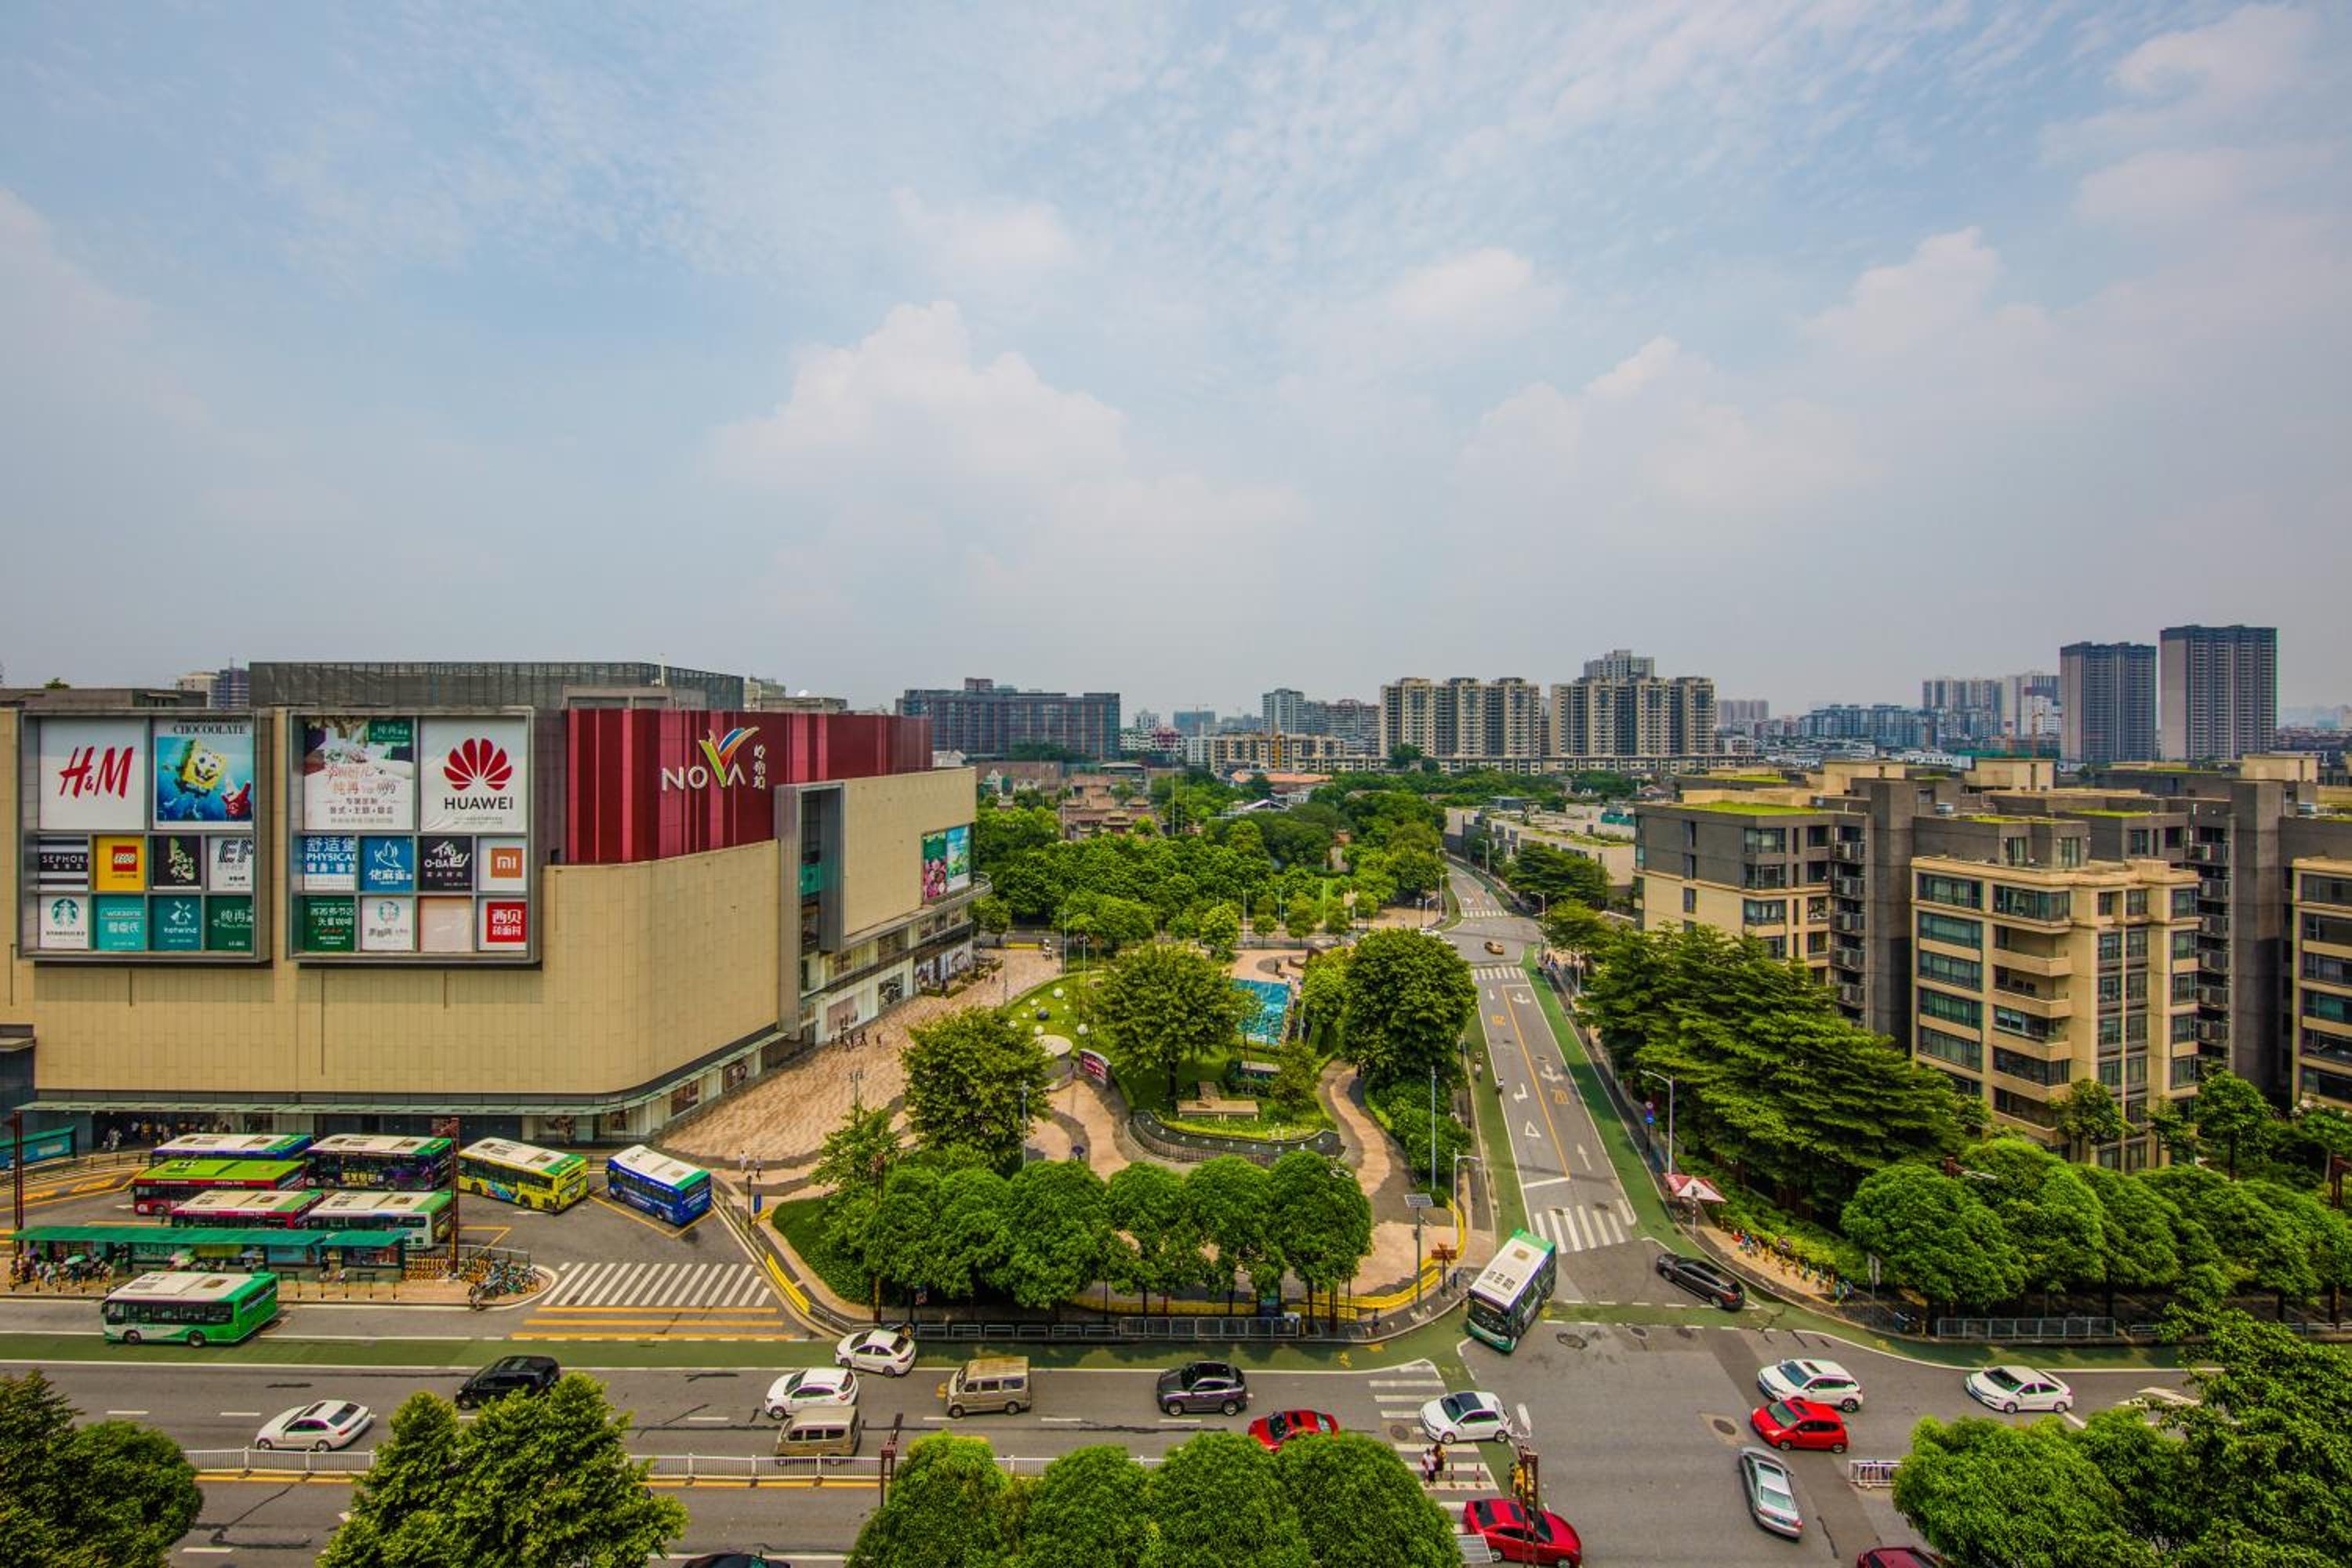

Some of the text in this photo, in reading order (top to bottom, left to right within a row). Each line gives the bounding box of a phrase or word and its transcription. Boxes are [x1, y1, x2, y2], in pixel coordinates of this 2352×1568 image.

[59, 746, 133, 798] H&M
[662, 726, 760, 791] NOVA
[445, 797, 514, 810] HUAWEI
[42, 855, 88, 863] SEPHOR
